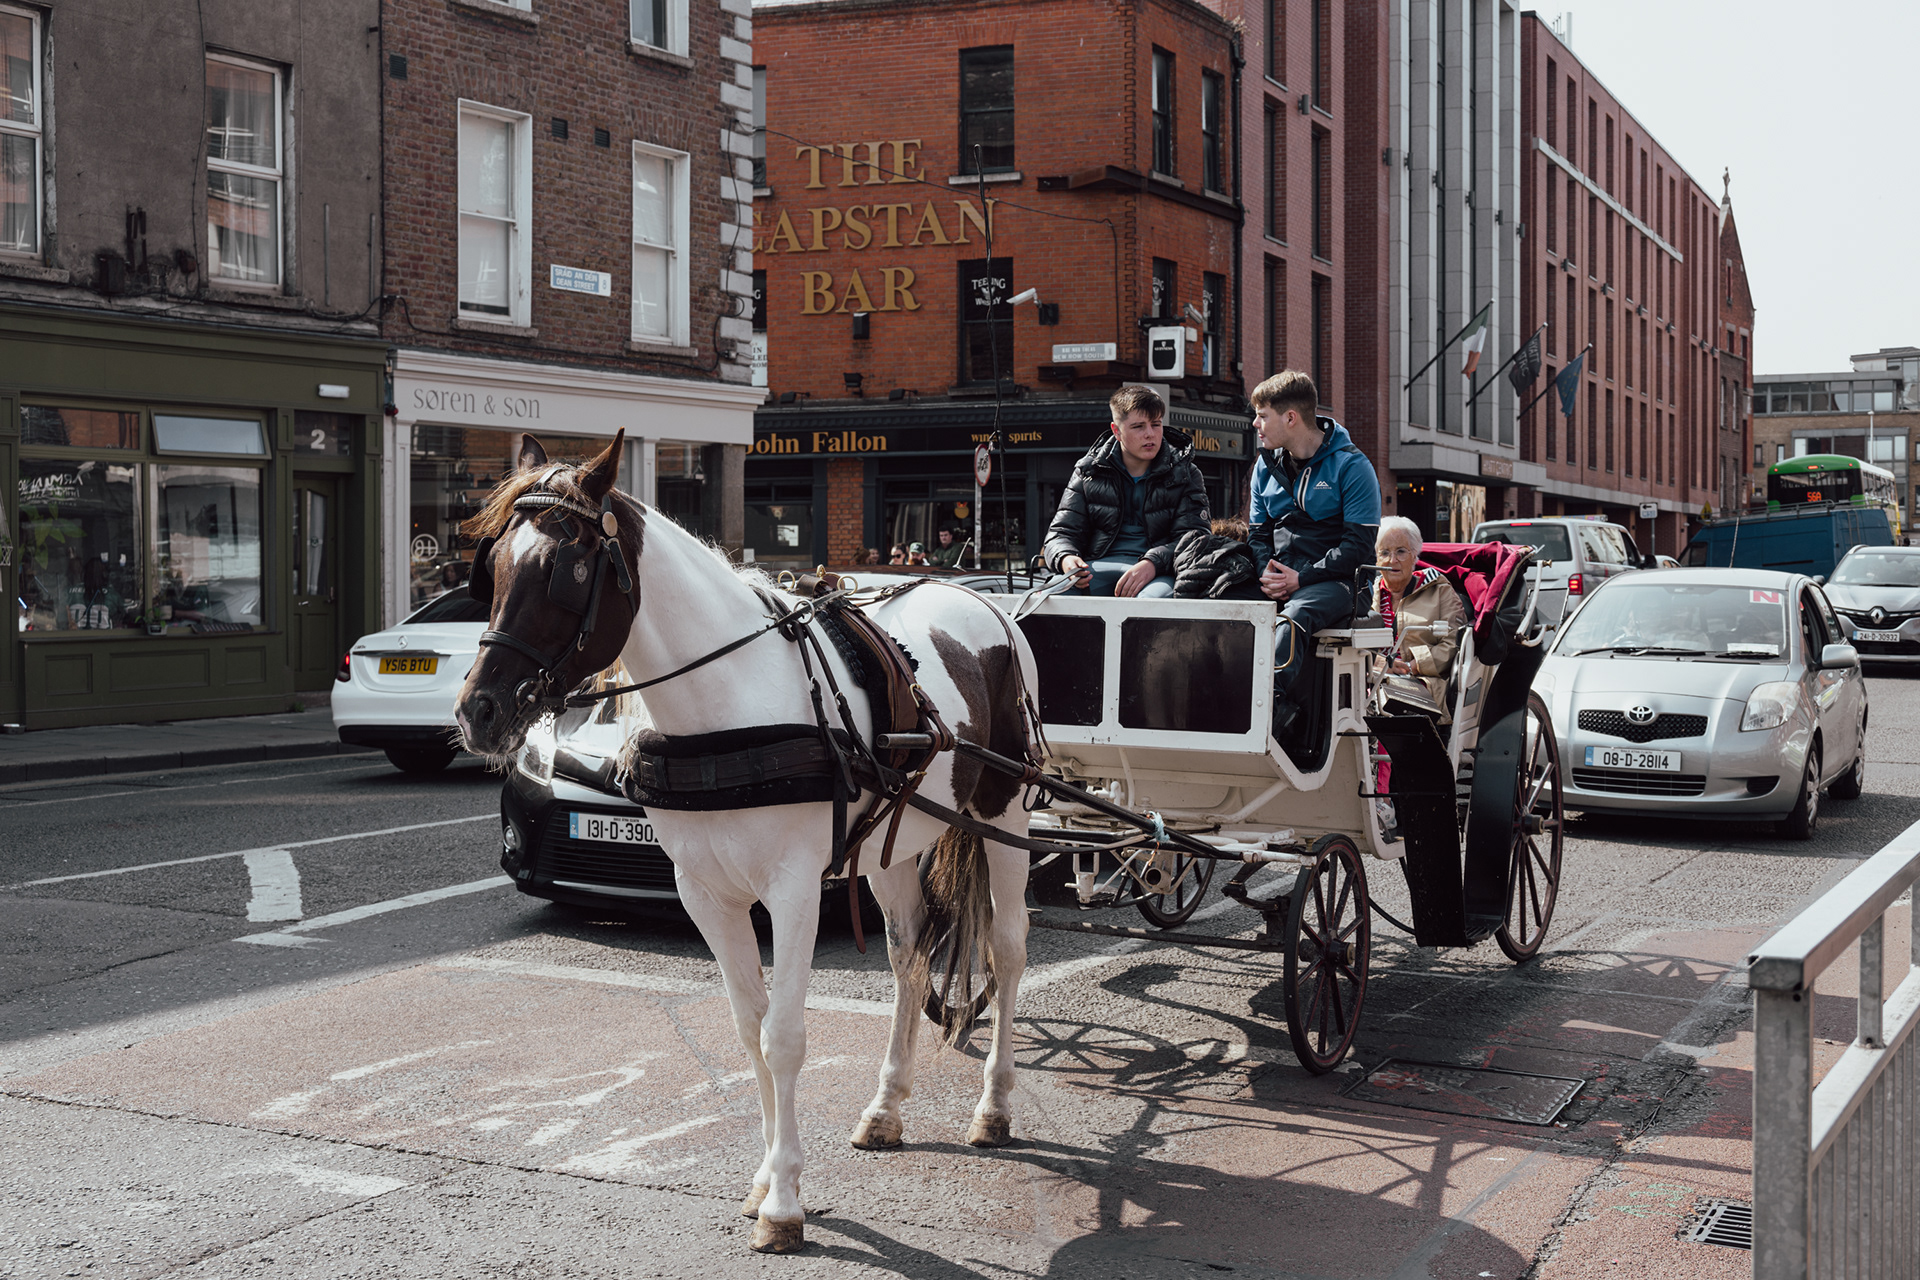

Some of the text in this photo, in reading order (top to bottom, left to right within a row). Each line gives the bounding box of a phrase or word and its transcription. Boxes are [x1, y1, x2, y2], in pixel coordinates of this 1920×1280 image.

[796, 139, 925, 190] THE
[556, 278, 595, 290] DEAN STREET
[800, 266, 922, 315] BAR
[413, 388, 541, 419] søren & son
[310, 429, 325, 449] 2
[812, 431, 887, 453] Fallon
[1008, 430, 1043, 443] spirits
[1806, 491, 1822, 502] 56A
[1753, 590, 1779, 604] N
[385, 658, 431, 672] YS16 BTU
[1603, 752, 1669, 769] 08-D-28114
[587, 819, 659, 843] 131-D-390
